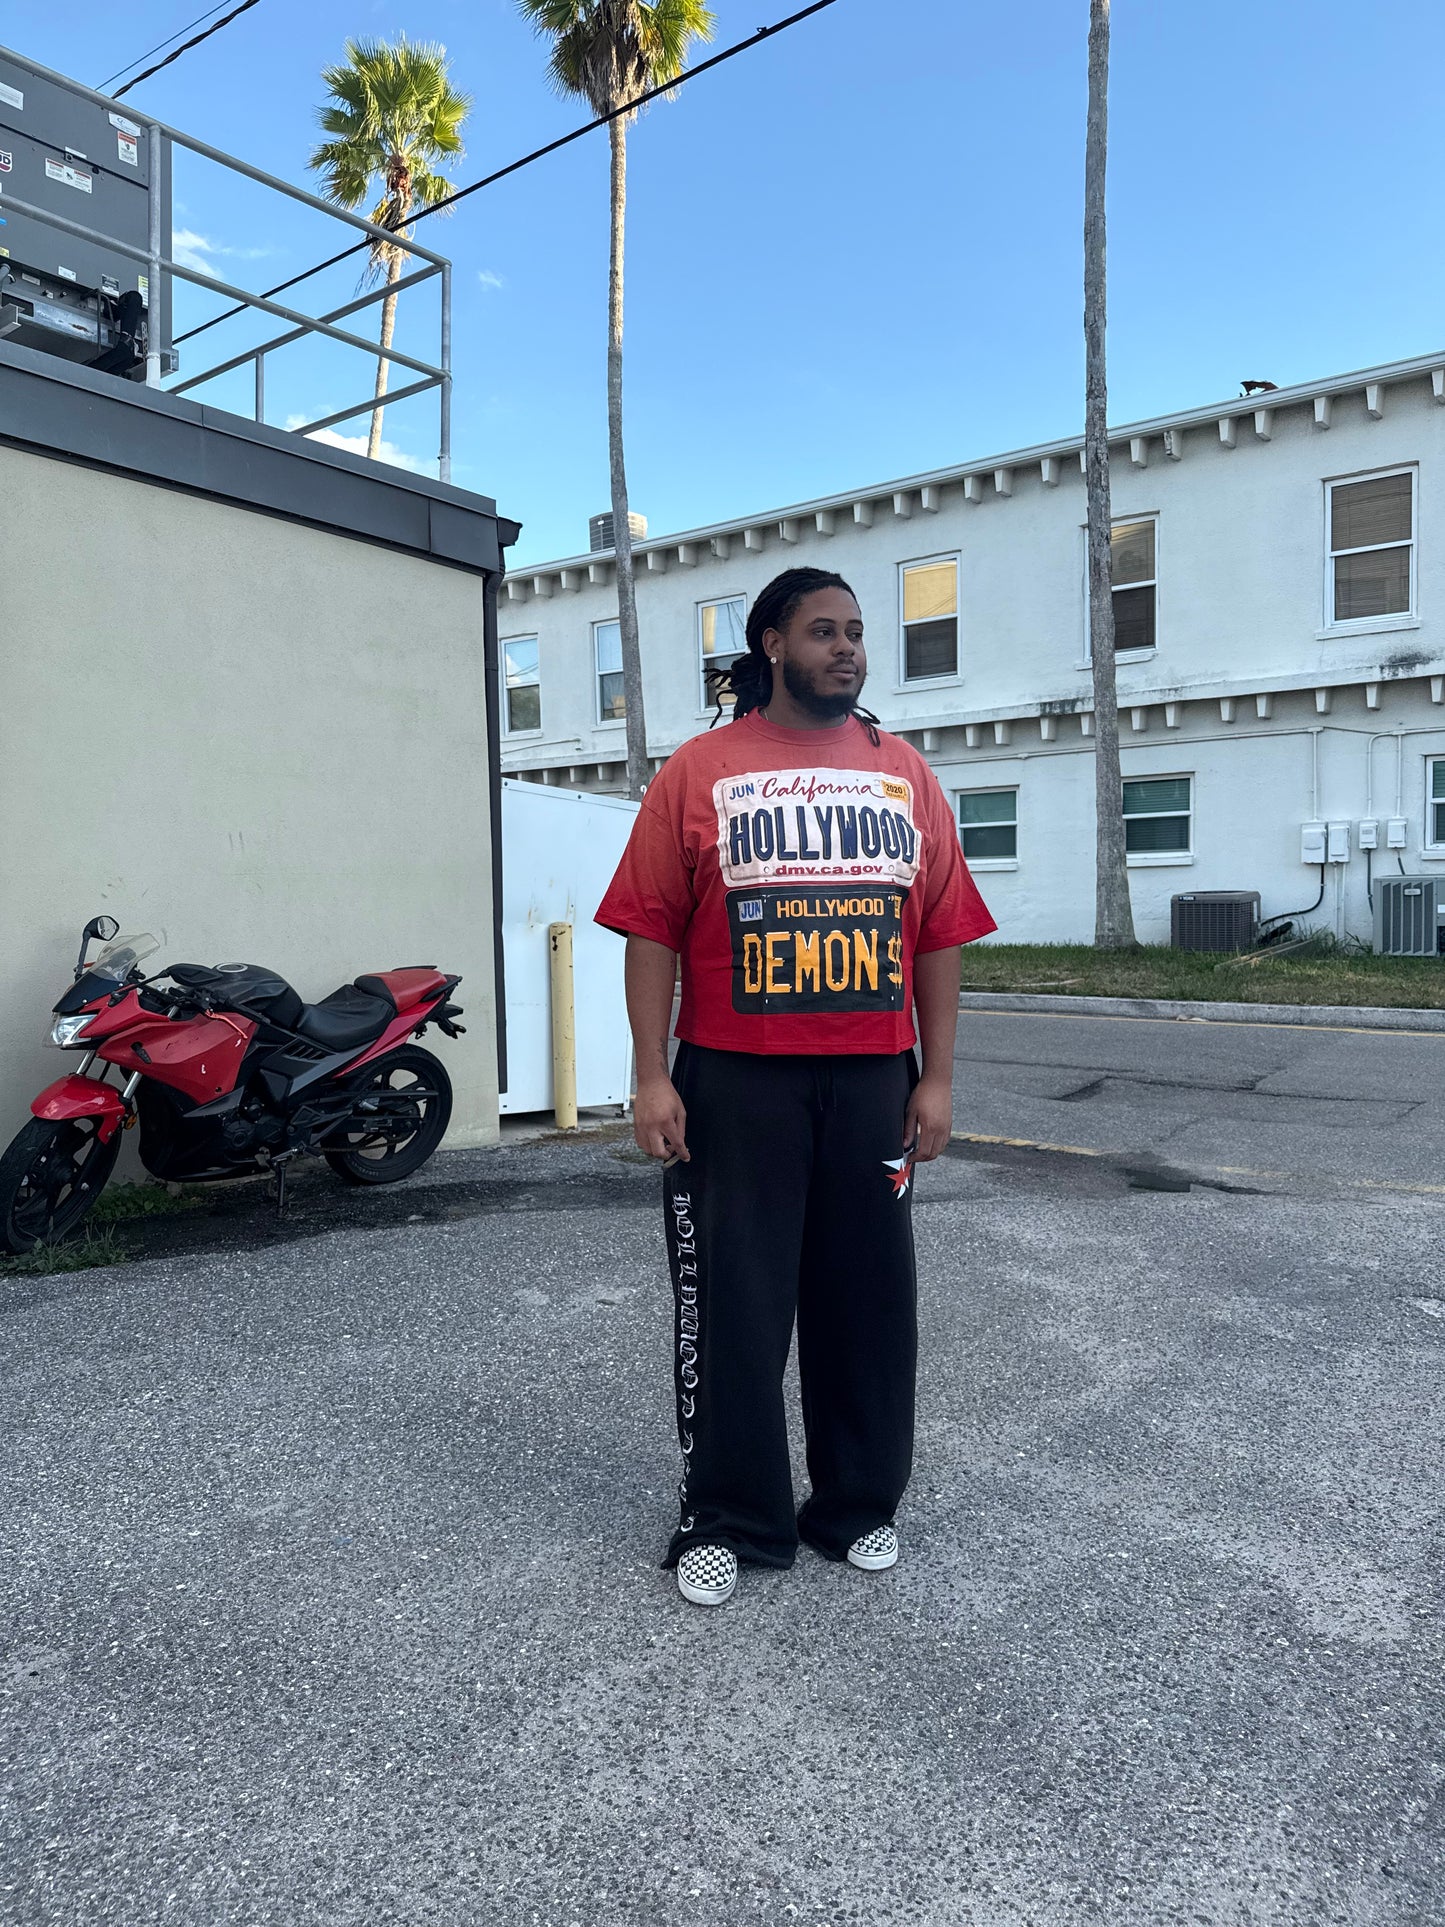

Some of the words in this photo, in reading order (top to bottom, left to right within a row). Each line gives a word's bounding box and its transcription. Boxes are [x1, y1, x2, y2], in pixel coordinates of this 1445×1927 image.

[729, 783, 755, 800] JUN
[761, 776, 885, 804] California
[885, 784, 903, 794] 2020
[729, 805, 915, 865] HOLLYWOOD
[775, 864, 883, 876] dmv.ca.gov
[740, 901, 761, 919] JUN
[776, 898, 884, 918] HOLLYWOOD
